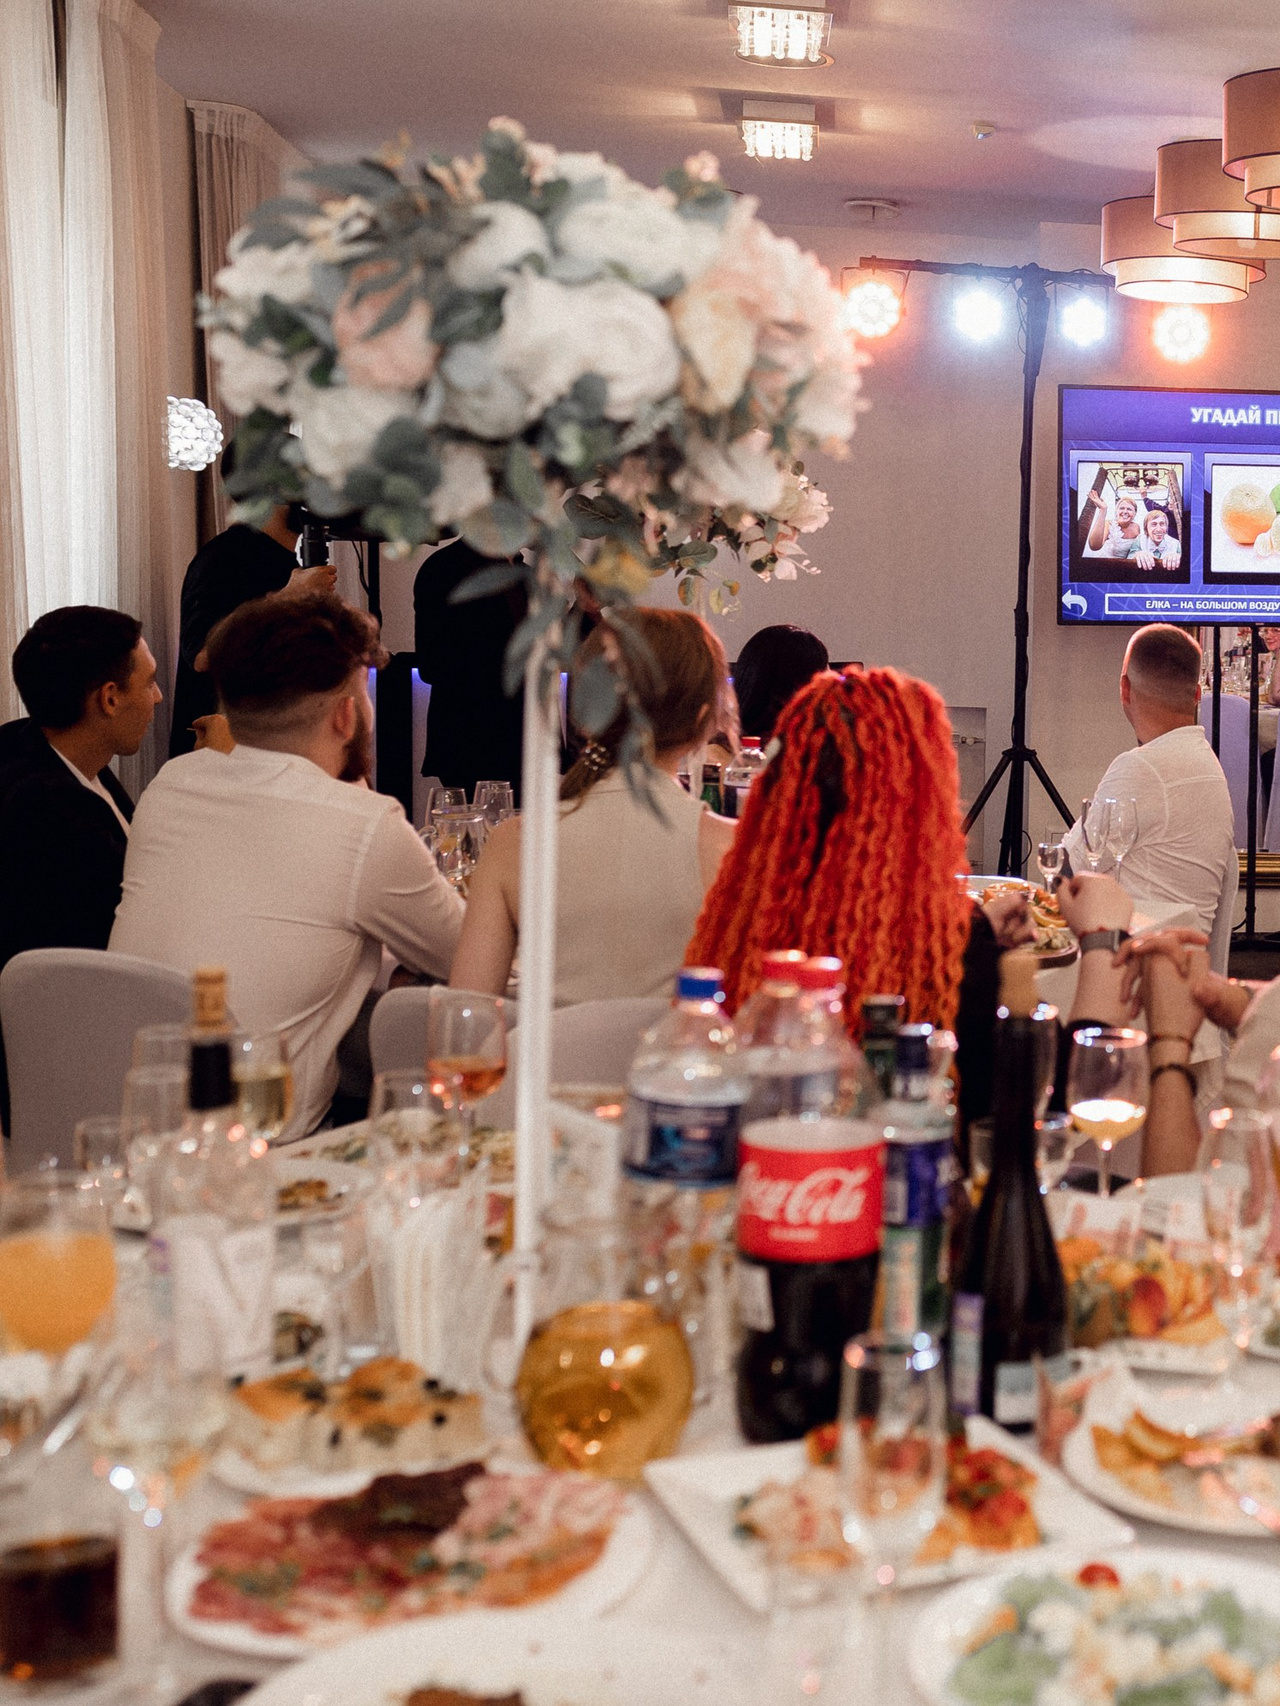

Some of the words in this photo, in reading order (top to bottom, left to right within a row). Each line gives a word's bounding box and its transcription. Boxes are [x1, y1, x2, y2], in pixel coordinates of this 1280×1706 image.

[1190, 404, 1261, 427] УГАДАЙ
[1145, 600, 1171, 610] ЕЛКА
[1180, 600, 1194, 610] НА
[1196, 600, 1247, 610] БОЛЬШОМ
